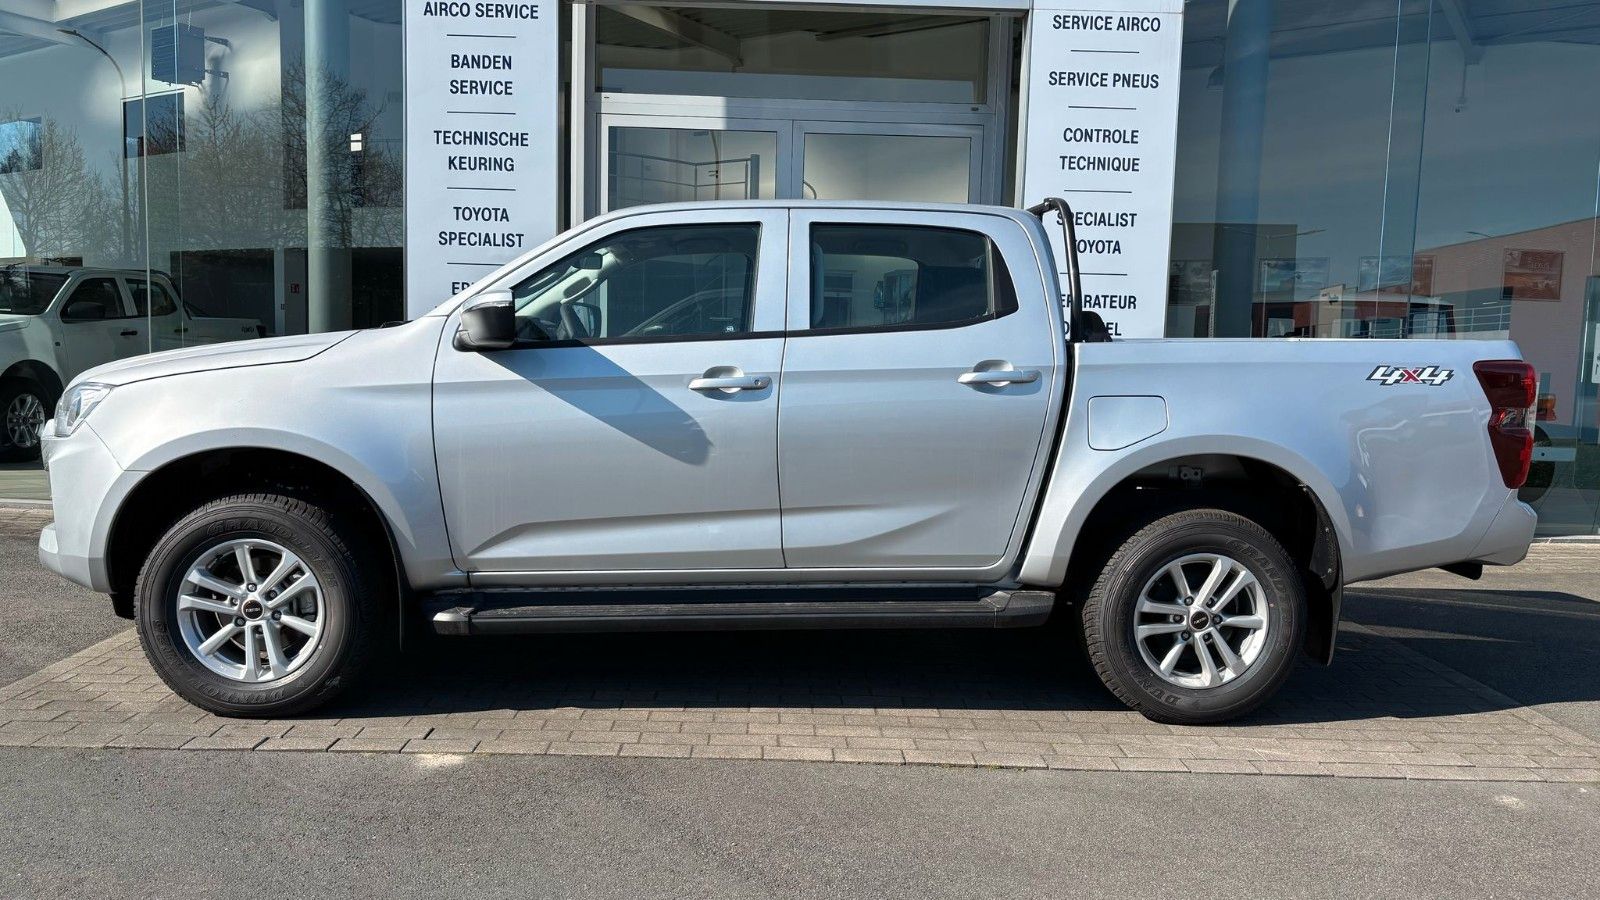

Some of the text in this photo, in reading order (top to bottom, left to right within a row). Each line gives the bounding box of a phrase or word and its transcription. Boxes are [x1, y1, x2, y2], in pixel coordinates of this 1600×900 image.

[423, 1, 539, 20] AIRCO SERVICE
[1052, 14, 1161, 32] SERVICE AIRCO
[451, 53, 512, 70] BANDEN
[449, 79, 513, 96] SERVICE
[1048, 71, 1159, 89] SERVICE PNEUS
[433, 130, 529, 147] TECHNISCHE
[1063, 127, 1139, 144] CONTROLE
[448, 155, 515, 172] KEURING
[1059, 155, 1140, 172] TECHNIQUE
[452, 206, 510, 222] TOYOTA
[1056, 211, 1137, 227] SECIALIST
[438, 230, 524, 248] SPECIALIST
[1075, 239, 1122, 254] OYOTA
